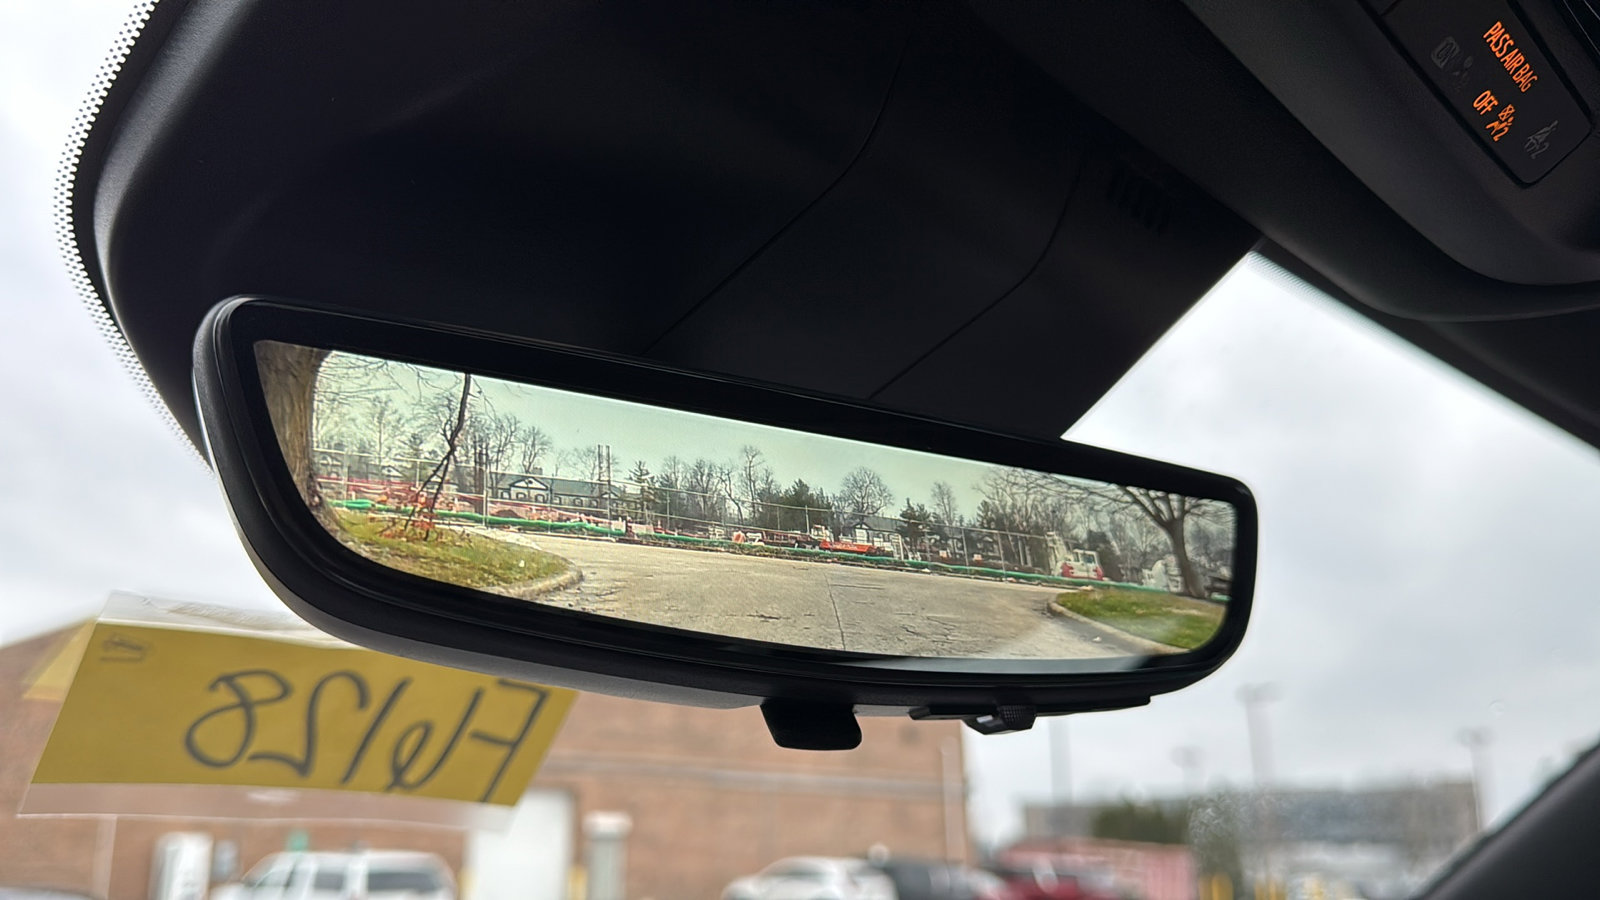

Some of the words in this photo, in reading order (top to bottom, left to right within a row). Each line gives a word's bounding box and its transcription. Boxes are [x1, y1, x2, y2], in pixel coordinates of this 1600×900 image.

[1483, 21, 1514, 58] PASS
[1500, 48, 1525, 75] AIR
[1512, 63, 1538, 92] BAG
[1473, 90, 1499, 115] OFF
